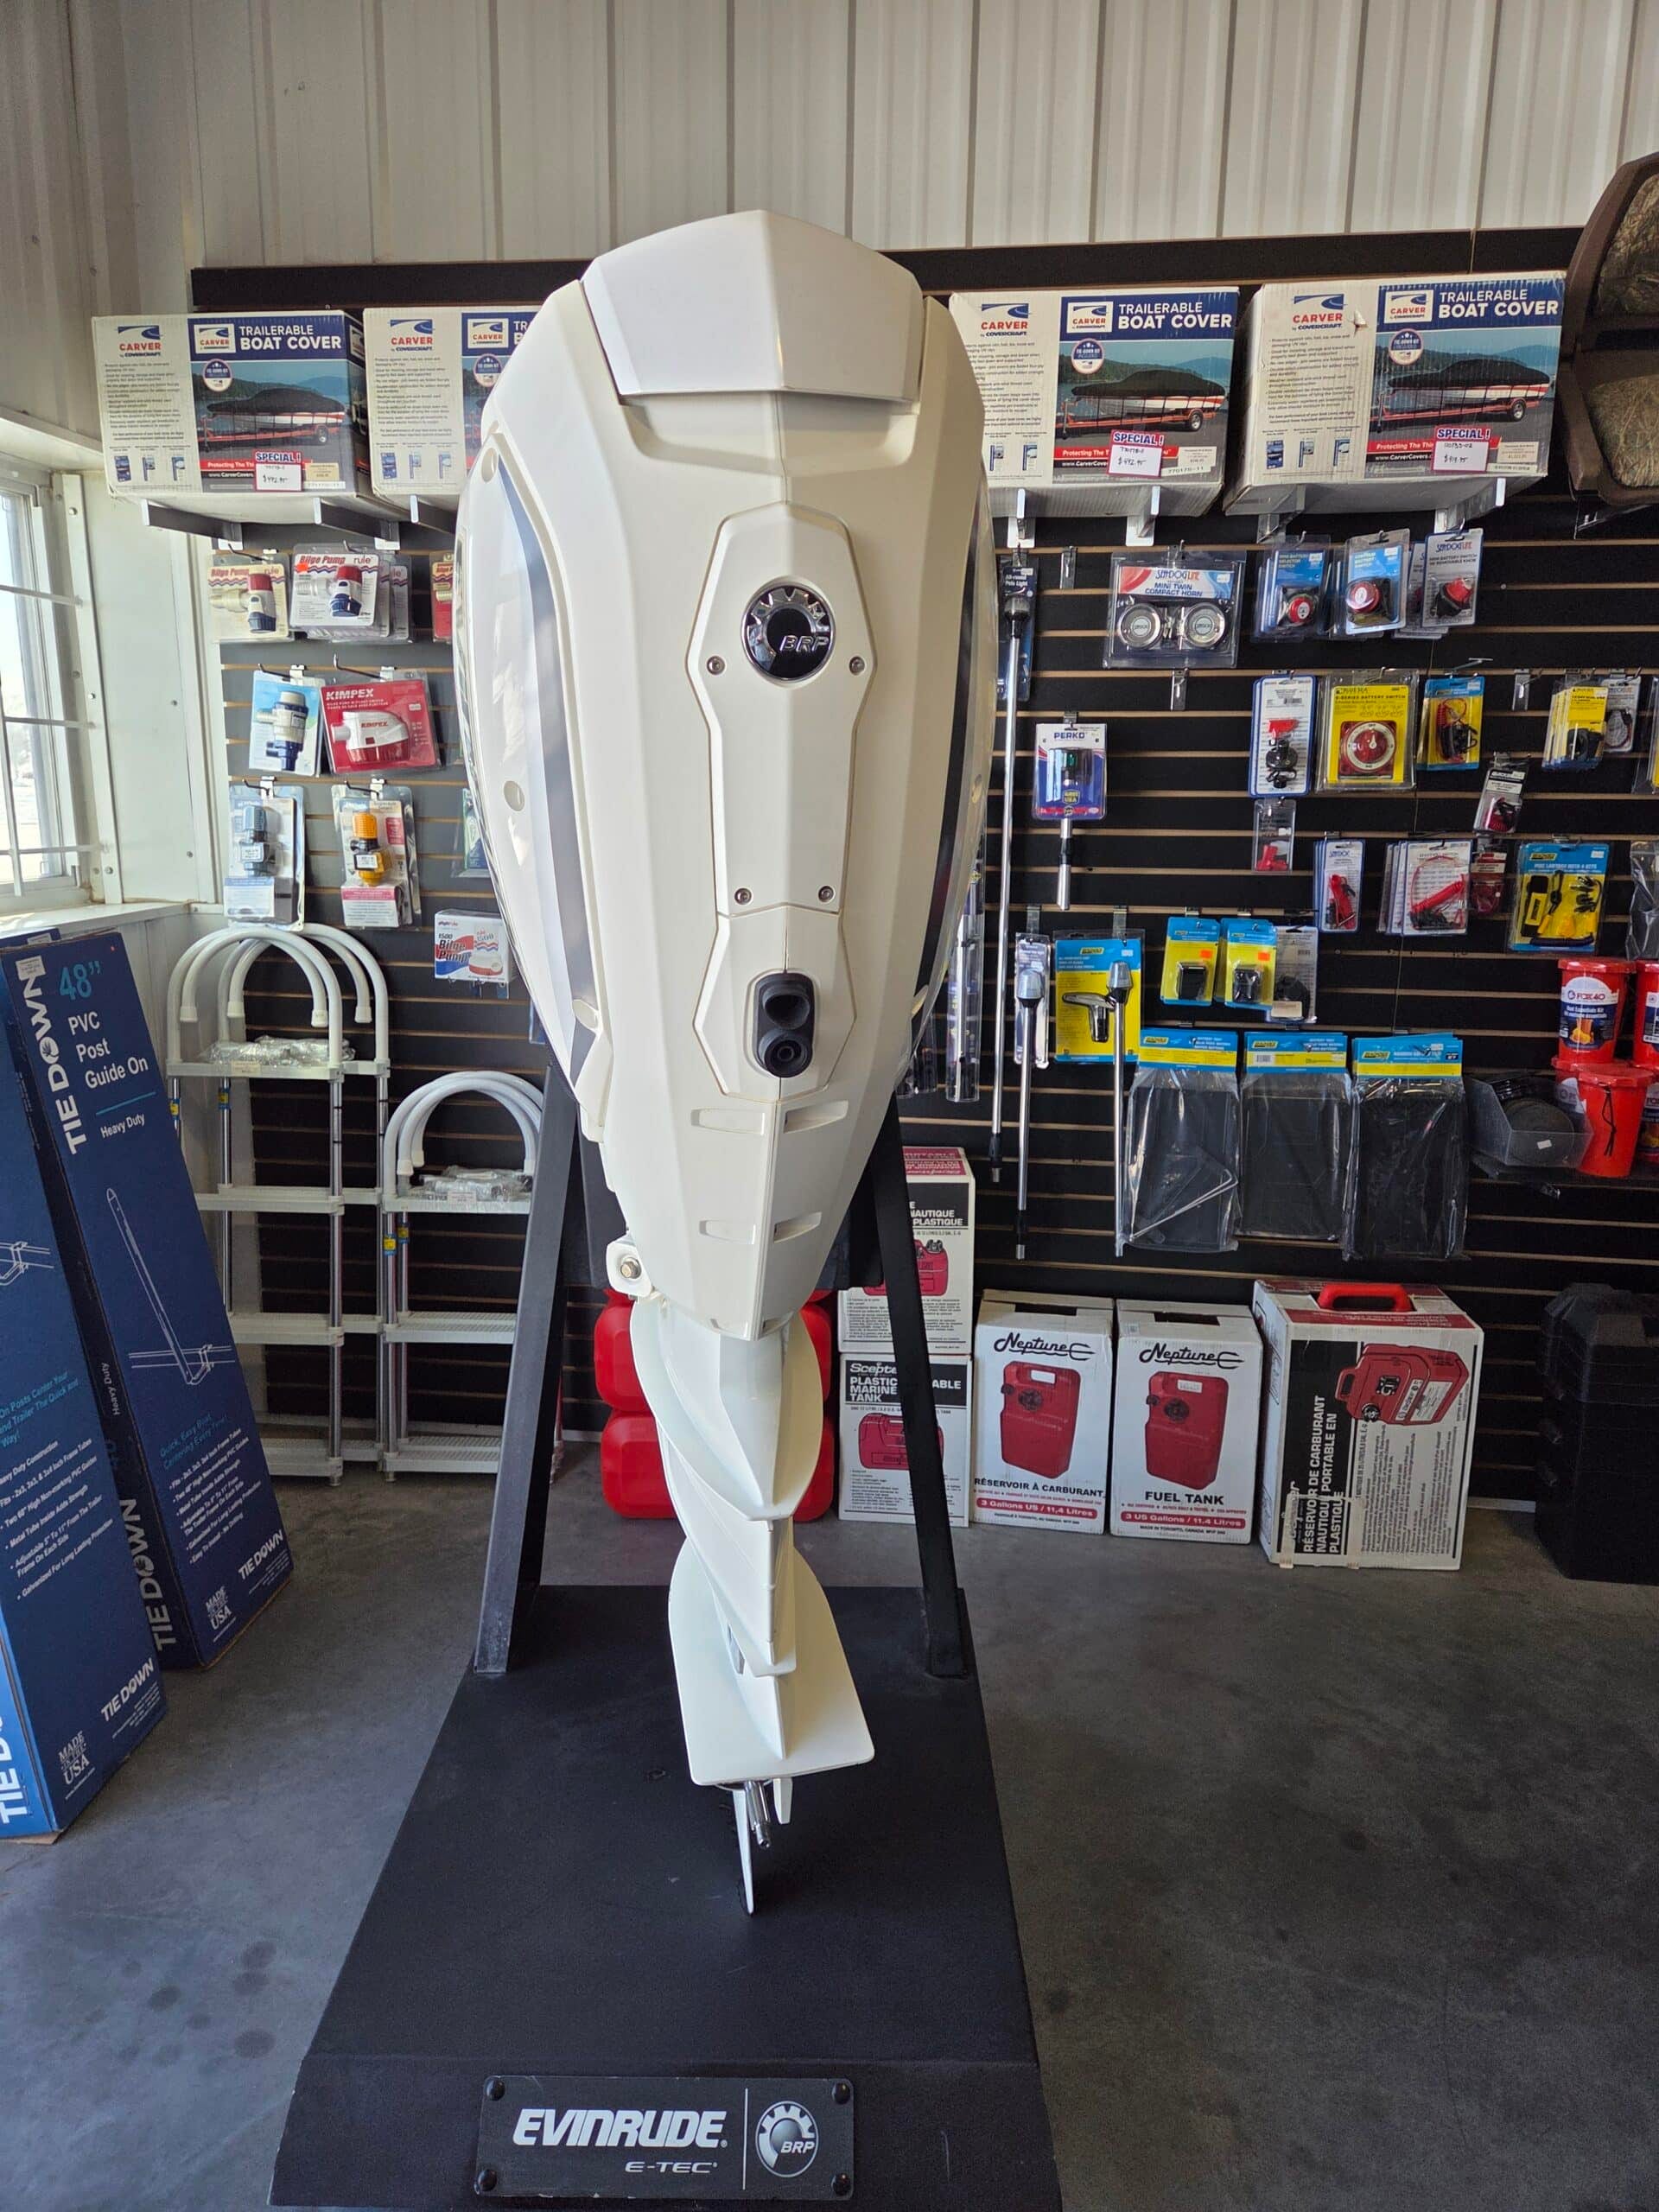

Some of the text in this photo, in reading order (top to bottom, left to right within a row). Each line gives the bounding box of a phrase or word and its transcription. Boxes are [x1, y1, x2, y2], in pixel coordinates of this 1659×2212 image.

[1440, 289, 1528, 302] TRAILERABLE
[1119, 302, 1203, 315] TRAILERABLE
[1293, 313, 1344, 323] CARVER
[1439, 301, 1559, 319] BOAT COVER
[239, 325, 315, 336] TRAILERABLE
[981, 321, 1028, 330] CARVER
[1118, 314, 1232, 329] BOAT COVER
[119, 342, 162, 351] CARVER
[240, 336, 342, 351] BOAT COVER
[391, 337, 433, 346] CARVER
[1114, 432, 1158, 445] SPECIAL
[1437, 429, 1483, 439] SPECIAL
[256, 452, 296, 461] SPECIAL
[300, 556, 346, 565] Bilge Pump
[779, 635, 830, 652] BRP
[326, 689, 374, 700] KIMPEX
[440, 939, 466, 950] Bilge
[439, 950, 470, 963] Pump
[68, 1011, 101, 1035] PVC
[76, 1037, 111, 1062] Post
[22, 974, 87, 1155] TIE DOWN
[85, 1056, 149, 1089] Guide On
[100, 1113, 146, 1139] Heavy Duty
[910, 1210, 955, 1218] NAUTIQUE
[912, 1217, 963, 1226] PLASTIQUE
[994, 1332, 1071, 1355] Neptune
[1139, 1342, 1218, 1365] Neptune
[850, 1363, 898, 1376] Scepte
[10, 1395, 32, 1411] Posts
[31, 1381, 54, 1398] Center
[54, 1371, 68, 1384] Your
[101, 1362, 120, 1416] Heavy Duty
[850, 1376, 899, 1387] PLASTIC
[850, 1386, 898, 1395] MARINE
[12, 1408, 35, 1425] Trailer
[35, 1399, 48, 1411] The
[48, 1386, 67, 1402] Quick
[850, 1394, 882, 1402] TANK
[1, 1427, 20, 1447] Way!
[13, 1440, 59, 1476] Duty Construction
[63, 1448, 79, 1462] Frame
[78, 1438, 92, 1452] Tubes
[975, 1478, 1029, 1491] RÉSERVOIR
[1302, 1395, 1325, 1553] RÉSERVOR DE CARBURANT
[1317, 1414, 1338, 1553] NAUTIQU PORTABLE EN
[4, 1515, 18, 1528] Two
[27, 1497, 41, 1512] High
[71, 1466, 82, 1479] PVC
[81, 1456, 98, 1471] Guides
[1145, 1491, 1224, 1505] FUEL TANK
[10, 1484, 88, 1548] Metal Tube Inside Adds Strength
[989, 1500, 1024, 1510] Gallons
[1066, 1508, 1093, 1516] Litres
[15, 1494, 103, 1568] Adjustable To From The Trailer
[1329, 1491, 1344, 1554] PLASTIQUE
[17, 1534, 70, 1578] Frame On Each Side
[22, 1518, 114, 1598] Galvanized For Long Lasting Protection
[238, 1557, 256, 1580] TIE
[253, 1529, 283, 1567] DOWN
[119, 1499, 176, 1652] TIE DOWN
[206, 1586, 226, 1609] MADE
[210, 1605, 232, 1630] USA
[100, 1694, 122, 1722] TIE
[120, 1657, 155, 1705] DOWN
[58, 1730, 86, 1763] MADE
[63, 1753, 91, 1785] USA
[0, 1767, 28, 1824] TIE
[512, 2107, 727, 2149] EVINRUDE
[625, 2140, 816, 2174] E-TEC BRP
